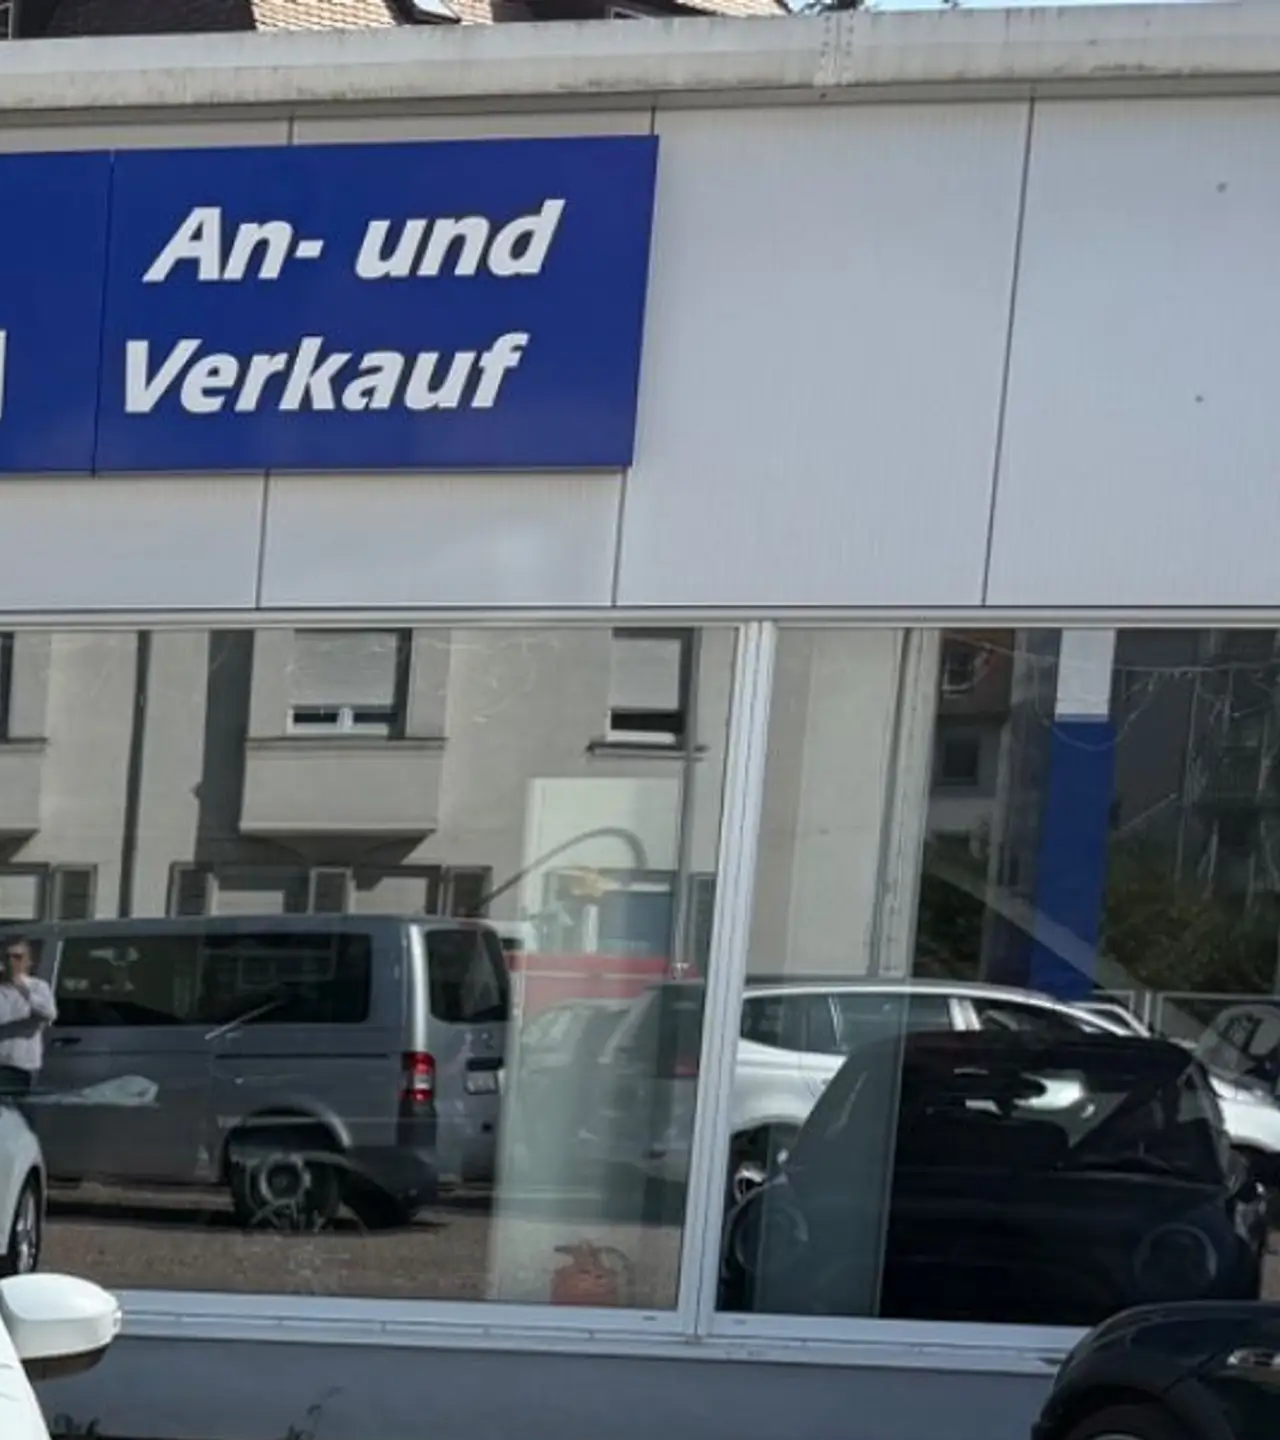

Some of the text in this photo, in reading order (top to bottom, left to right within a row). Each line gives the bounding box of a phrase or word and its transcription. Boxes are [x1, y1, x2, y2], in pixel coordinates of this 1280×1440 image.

[143, 200, 565, 281] An- und
[126, 333, 528, 412] Verkauf
